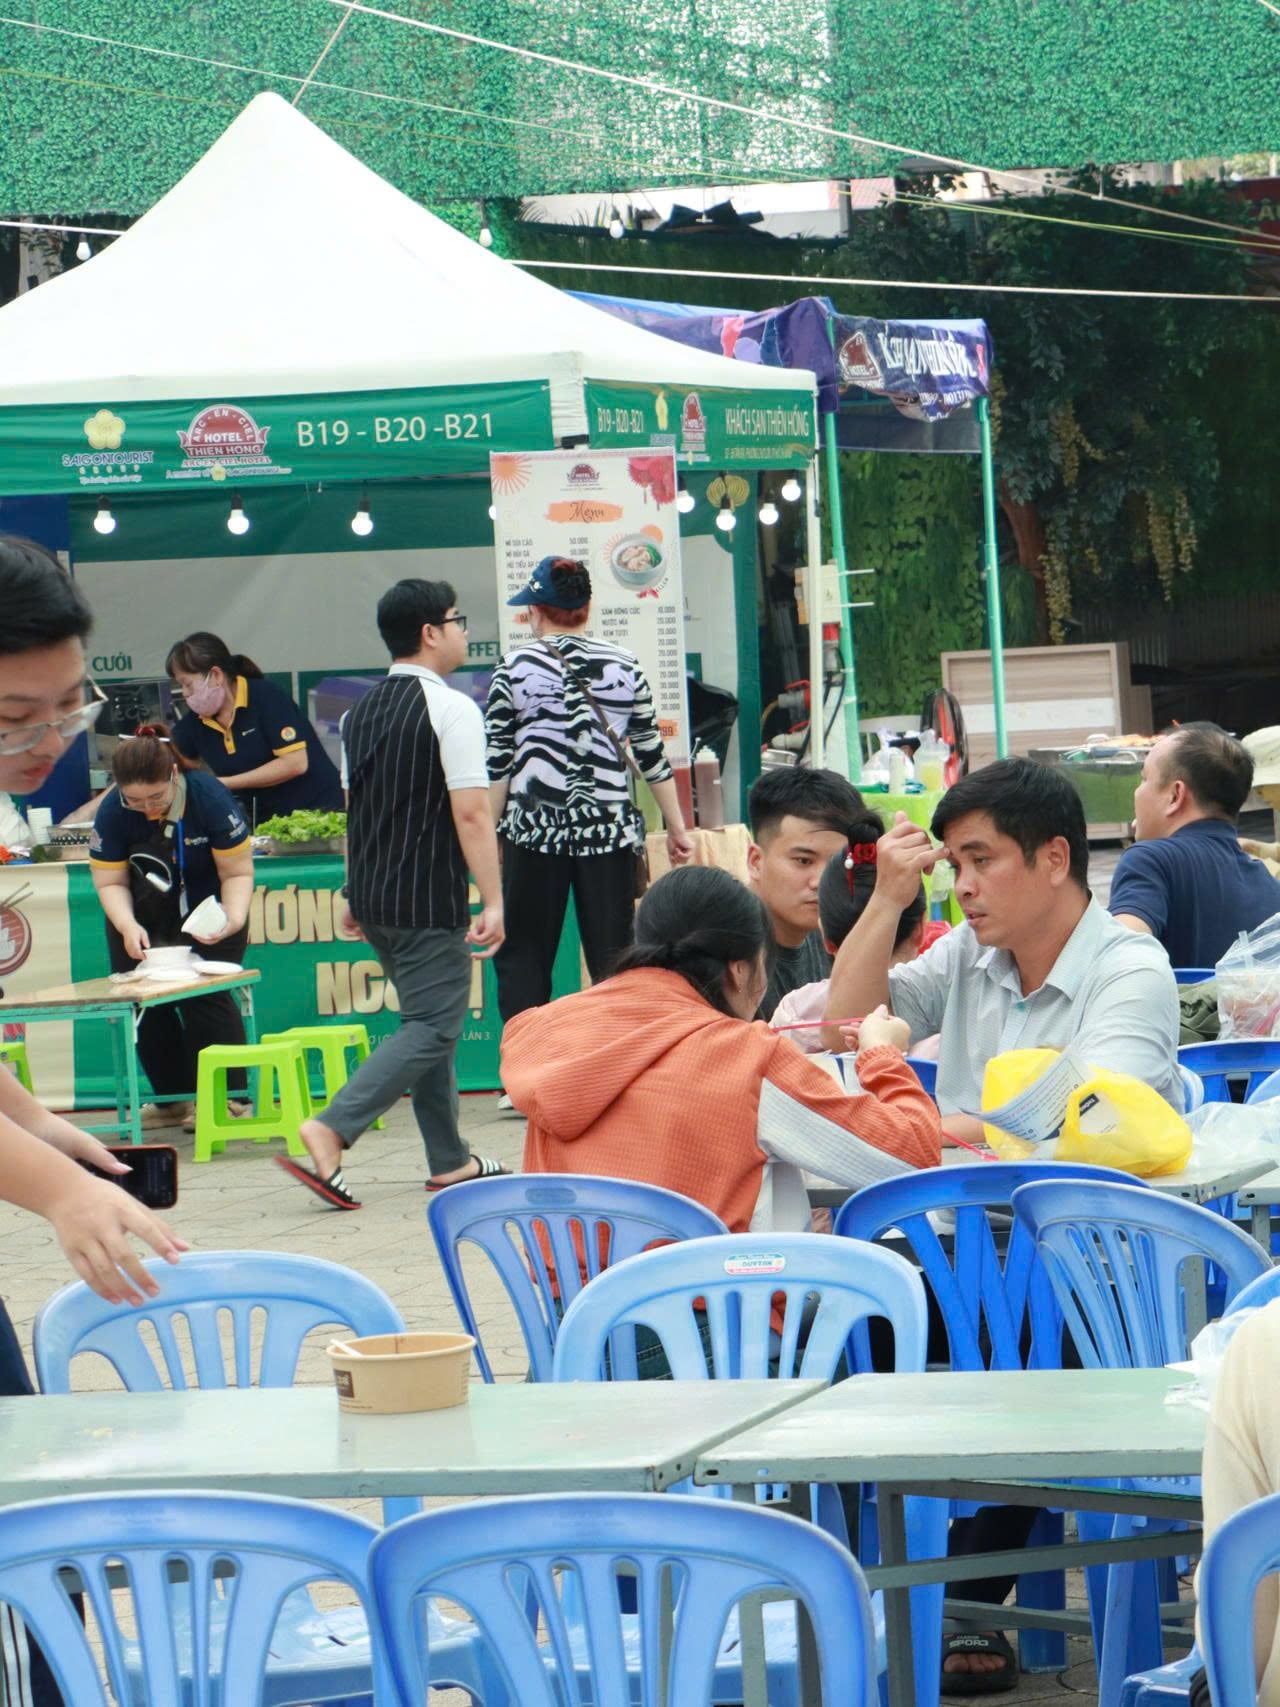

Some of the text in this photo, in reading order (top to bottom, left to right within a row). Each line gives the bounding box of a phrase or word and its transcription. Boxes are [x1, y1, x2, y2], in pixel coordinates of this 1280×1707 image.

[214, 409, 229, 417] EN
[597, 407, 611, 433] B19
[616, 408, 629, 433] B20
[204, 432, 243, 443] HOTEL
[297, 419, 349, 447] B19
[375, 415, 427, 443] B20
[187, 444, 262, 456] THIEN HONG
[62, 451, 154, 467] SAIGONTOURIST
[569, 501, 605, 523] Menu
